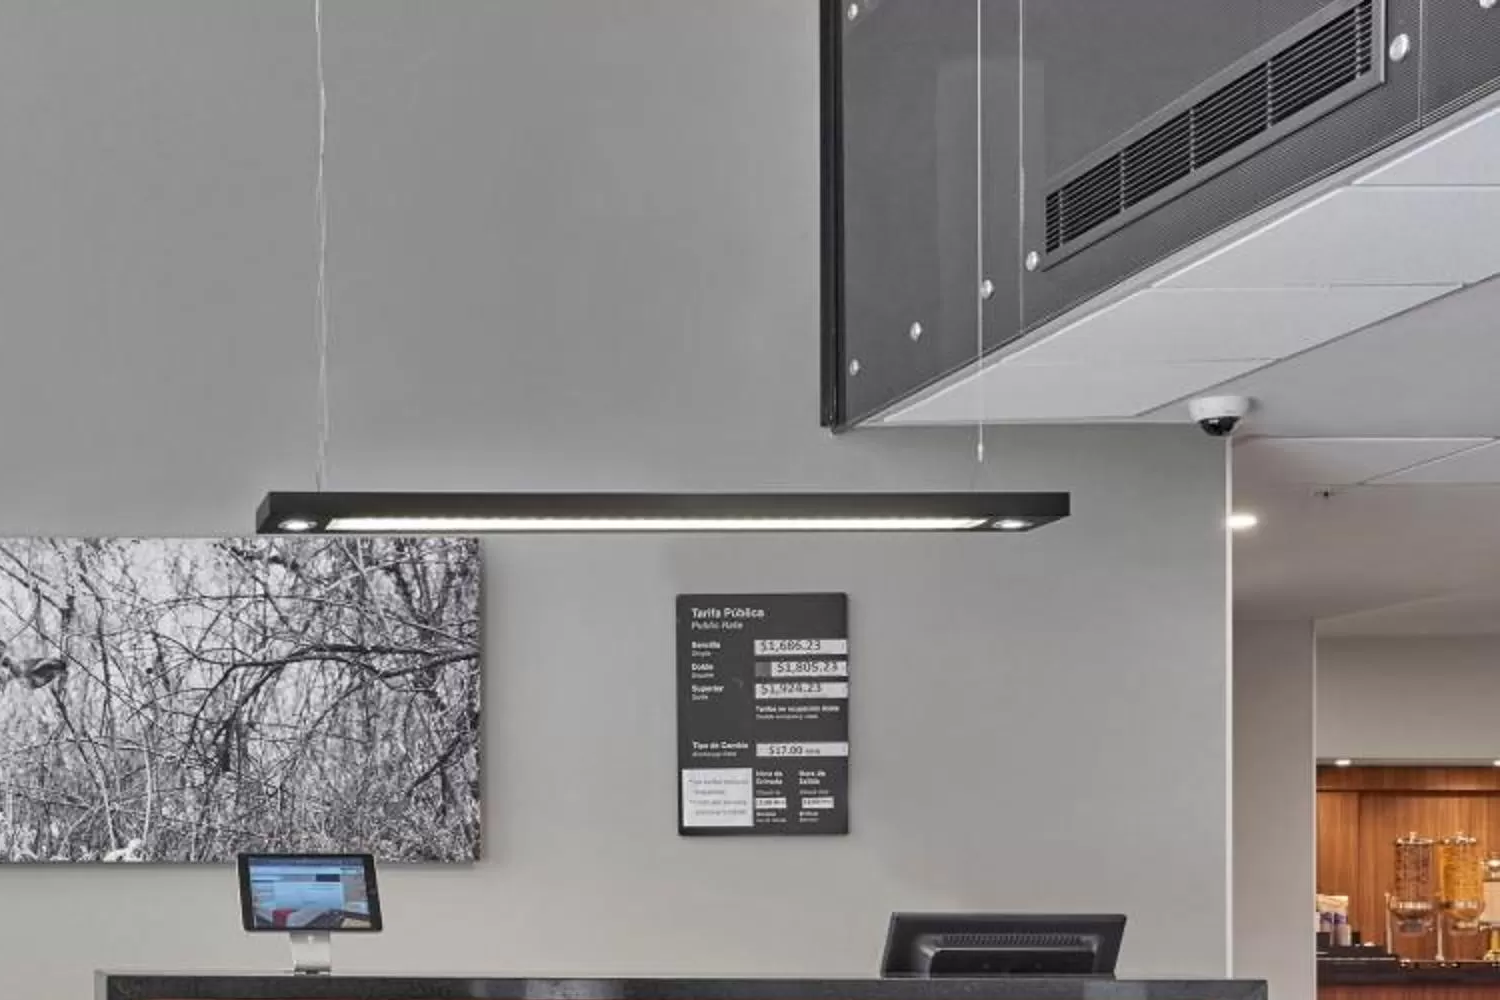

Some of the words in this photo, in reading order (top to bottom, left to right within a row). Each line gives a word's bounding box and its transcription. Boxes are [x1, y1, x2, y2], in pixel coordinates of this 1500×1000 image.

[691, 607, 721, 618] Tarifa
[723, 607, 765, 618] Pública
[768, 745, 803, 755] $17.00
